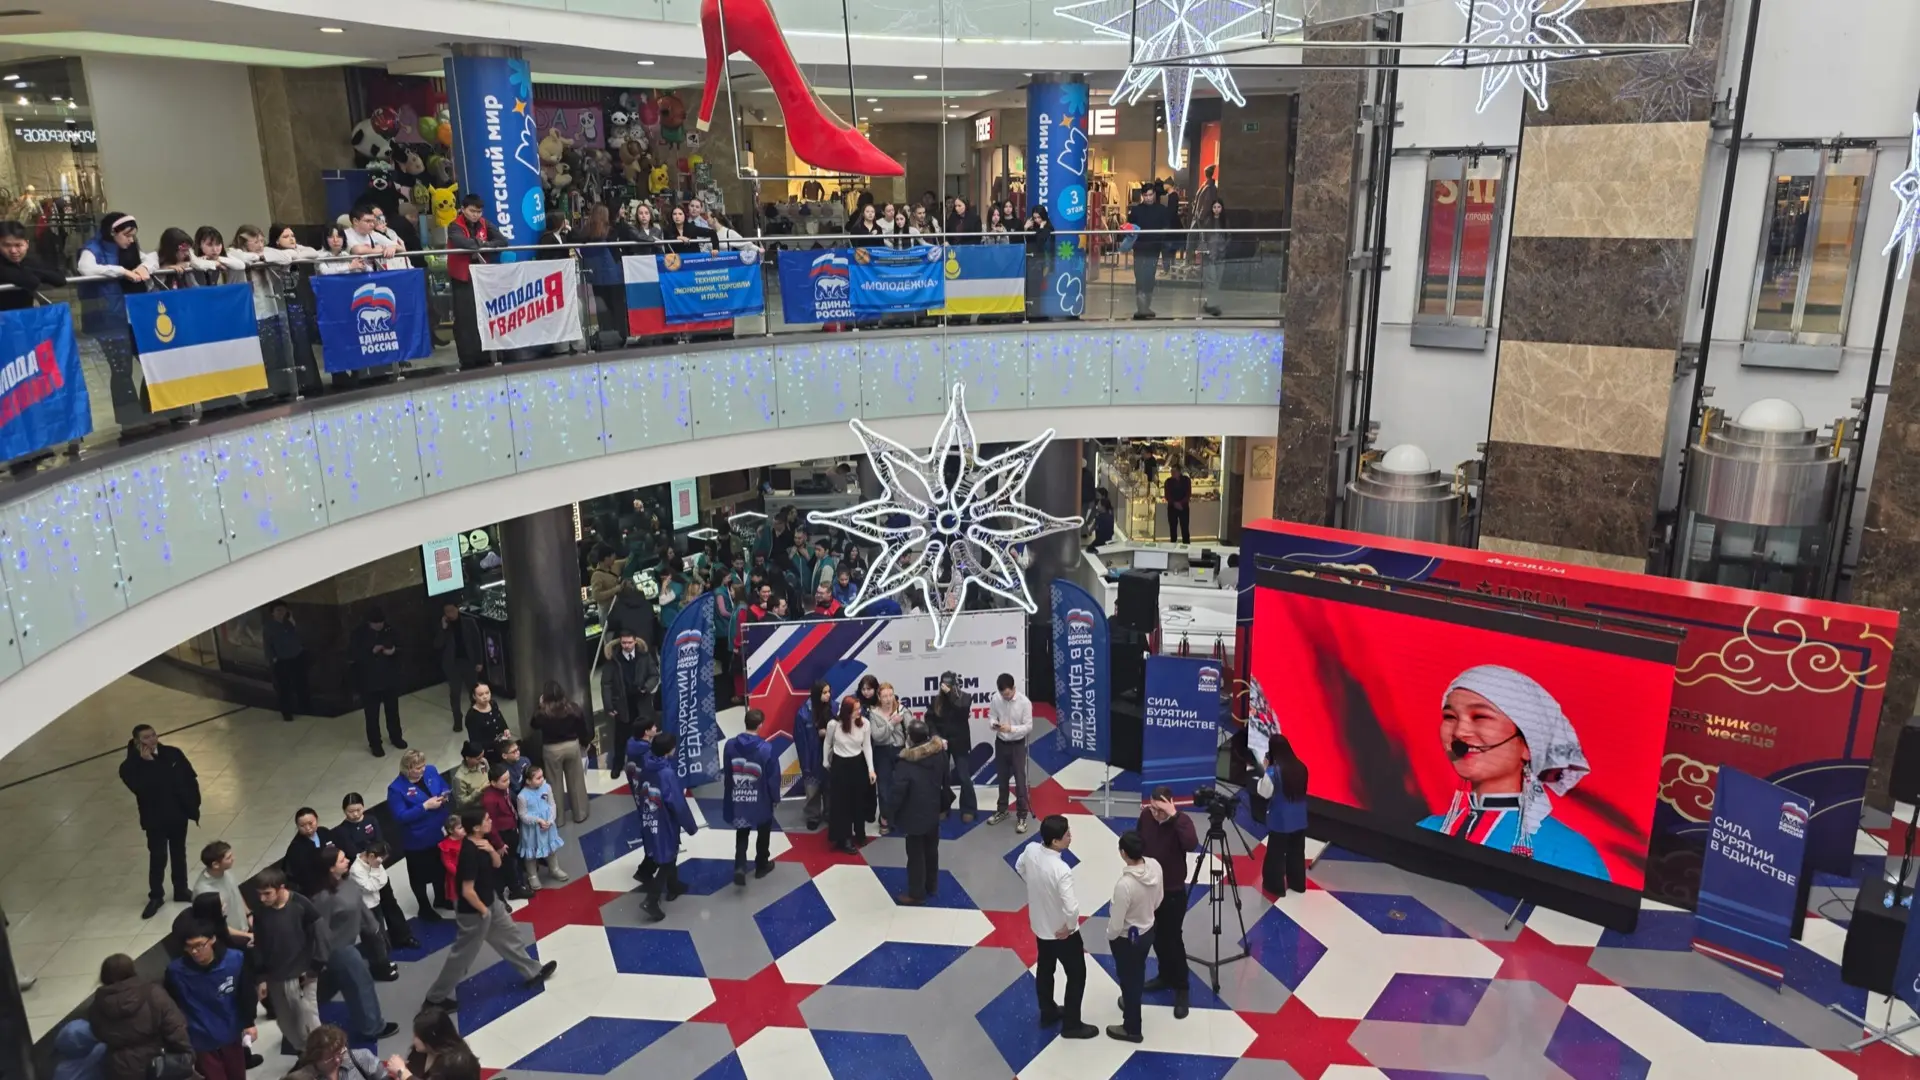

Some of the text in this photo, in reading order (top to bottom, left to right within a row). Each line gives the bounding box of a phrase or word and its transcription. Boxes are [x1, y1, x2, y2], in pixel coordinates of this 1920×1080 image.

[484, 94, 515, 240] детский мир
[1036, 113, 1052, 211] тский мир
[534, 194, 541, 211] 3
[1070, 190, 1078, 204] 3
[486, 271, 564, 318] МОЛОДАЯ
[359, 331, 398, 346] ЕДИНАЯ
[361, 341, 399, 355] РОССИЯ
[1068, 648, 1083, 748] В ЕДИНСТВЕ
[1084, 647, 1096, 751] СИЛА БУРЯТИИ
[1147, 697, 1178, 707] СИЛА
[1146, 708, 1198, 718] БУРЯТИИ
[1156, 718, 1216, 730] ЕДИНСТВЕ
[1706, 727, 1774, 748] месяца
[690, 762, 702, 773] В
[1715, 816, 1752, 840] СИЛА
[1712, 828, 1774, 863] БУРЯТИИ
[1710, 840, 1796, 886] В ЕДИНСТВЕ
